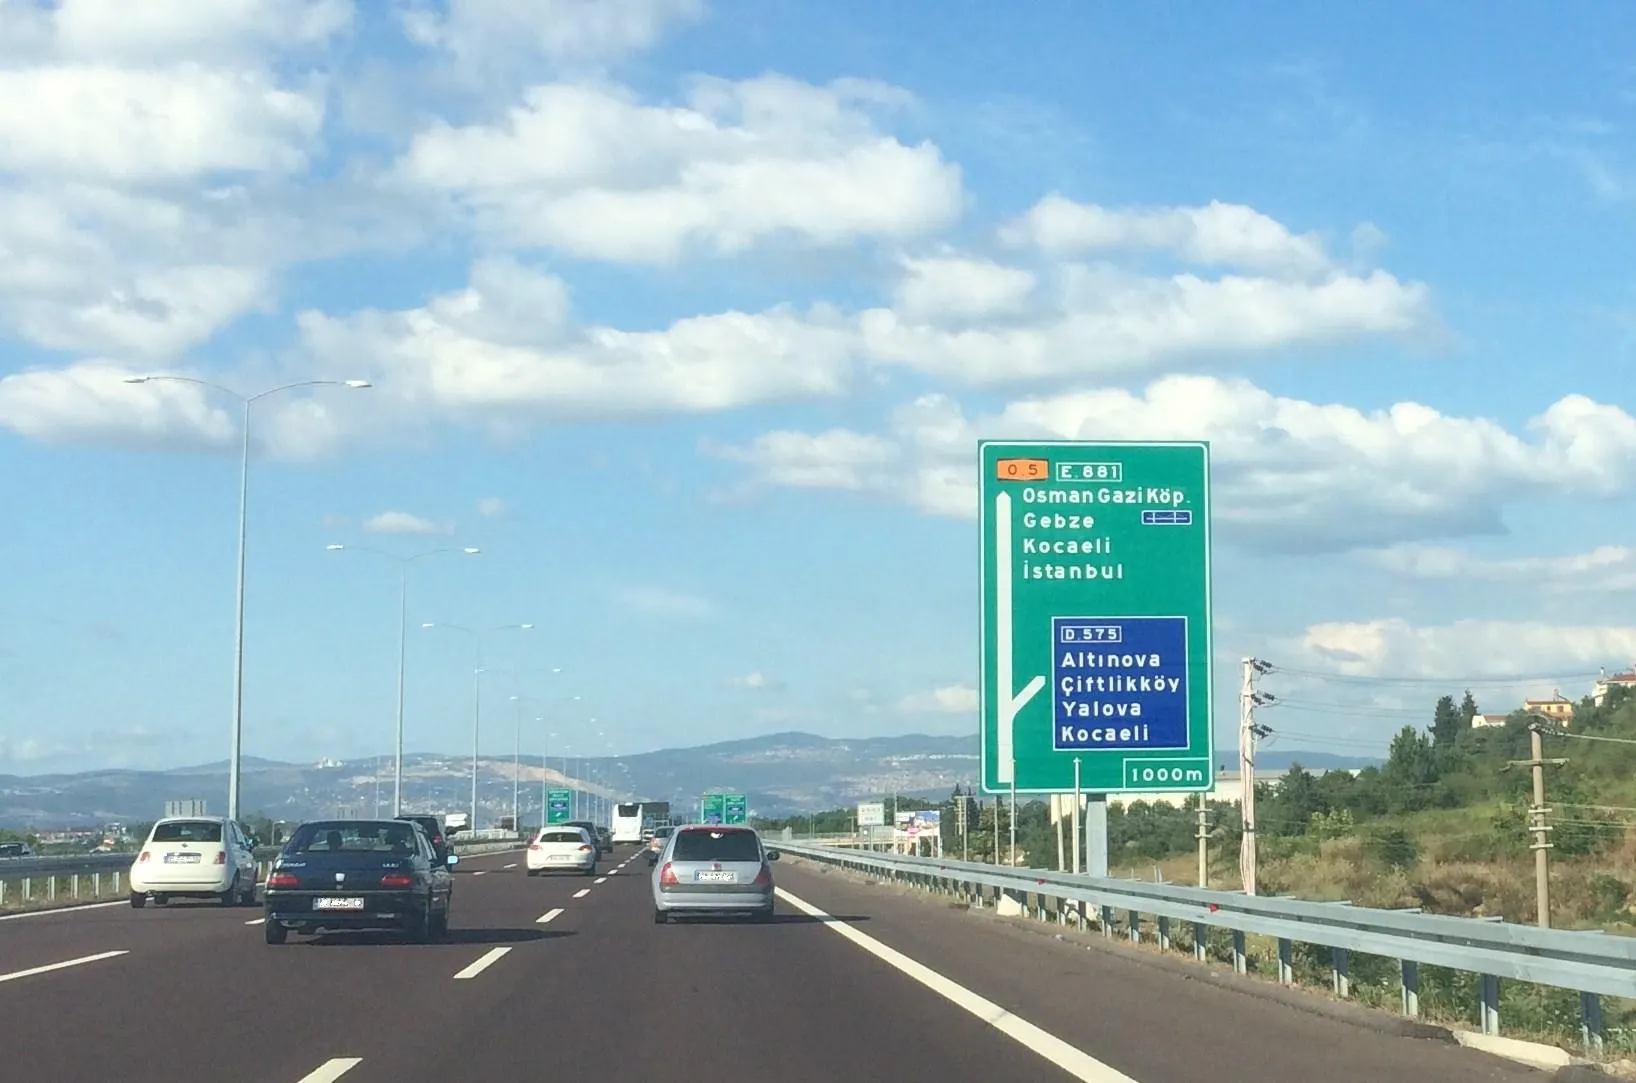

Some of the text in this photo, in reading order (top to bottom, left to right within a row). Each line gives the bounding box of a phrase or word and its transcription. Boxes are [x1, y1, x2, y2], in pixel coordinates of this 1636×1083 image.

[1061, 465, 1117, 479] E.881
[1023, 487, 1094, 504] Osman
[1098, 486, 1143, 504] Gazi
[1023, 512, 1095, 528] Gebze
[1023, 537, 1111, 554] Kocaeli
[1023, 560, 1123, 580] İstanbul
[1065, 628, 1117, 641] D.575
[1061, 651, 1161, 668] Altınova
[1061, 675, 1180, 697] Çiftlikköy
[1062, 701, 1142, 717] Yalova
[1061, 724, 1150, 742] Kocaeli
[1132, 768, 1203, 782] 1000m
